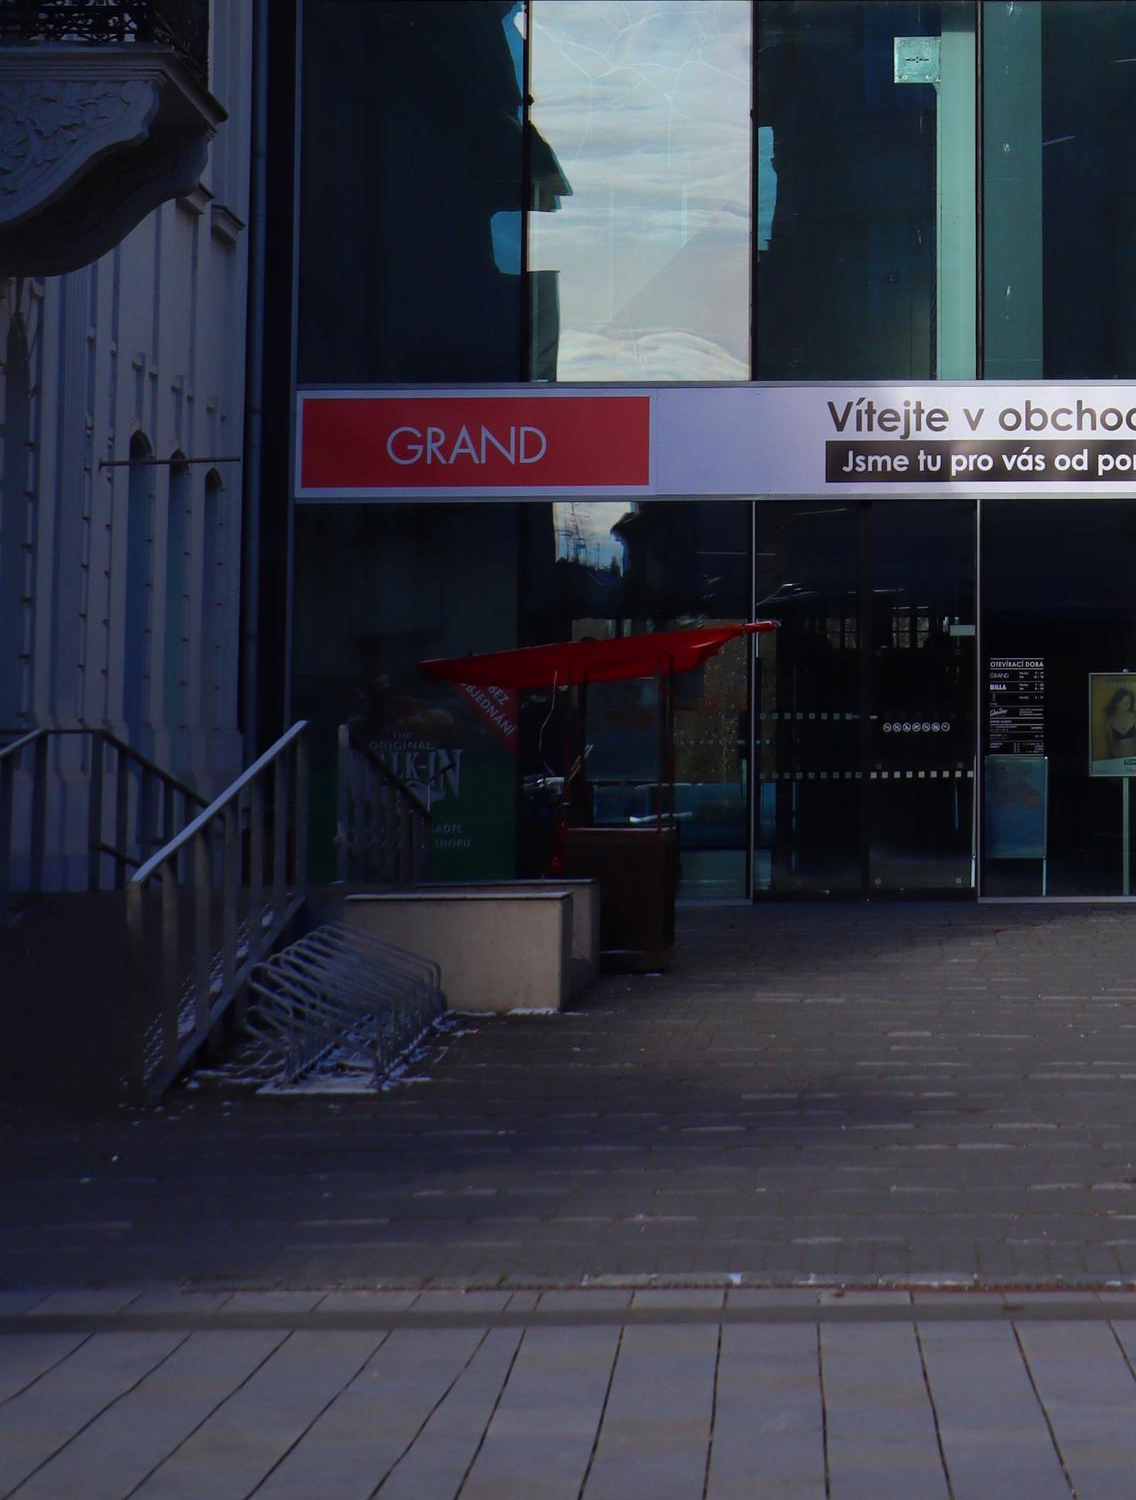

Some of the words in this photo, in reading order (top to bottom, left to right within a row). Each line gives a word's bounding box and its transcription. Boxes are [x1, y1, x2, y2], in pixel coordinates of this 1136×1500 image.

[827, 397, 949, 439] Vítejte
[963, 408, 985, 431] v
[386, 425, 547, 465] GRAND
[842, 450, 909, 472] Jsme
[918, 449, 942, 472] tu
[951, 453, 994, 477] pro
[1001, 446, 1046, 472] vás
[1054, 449, 1088, 471] od
